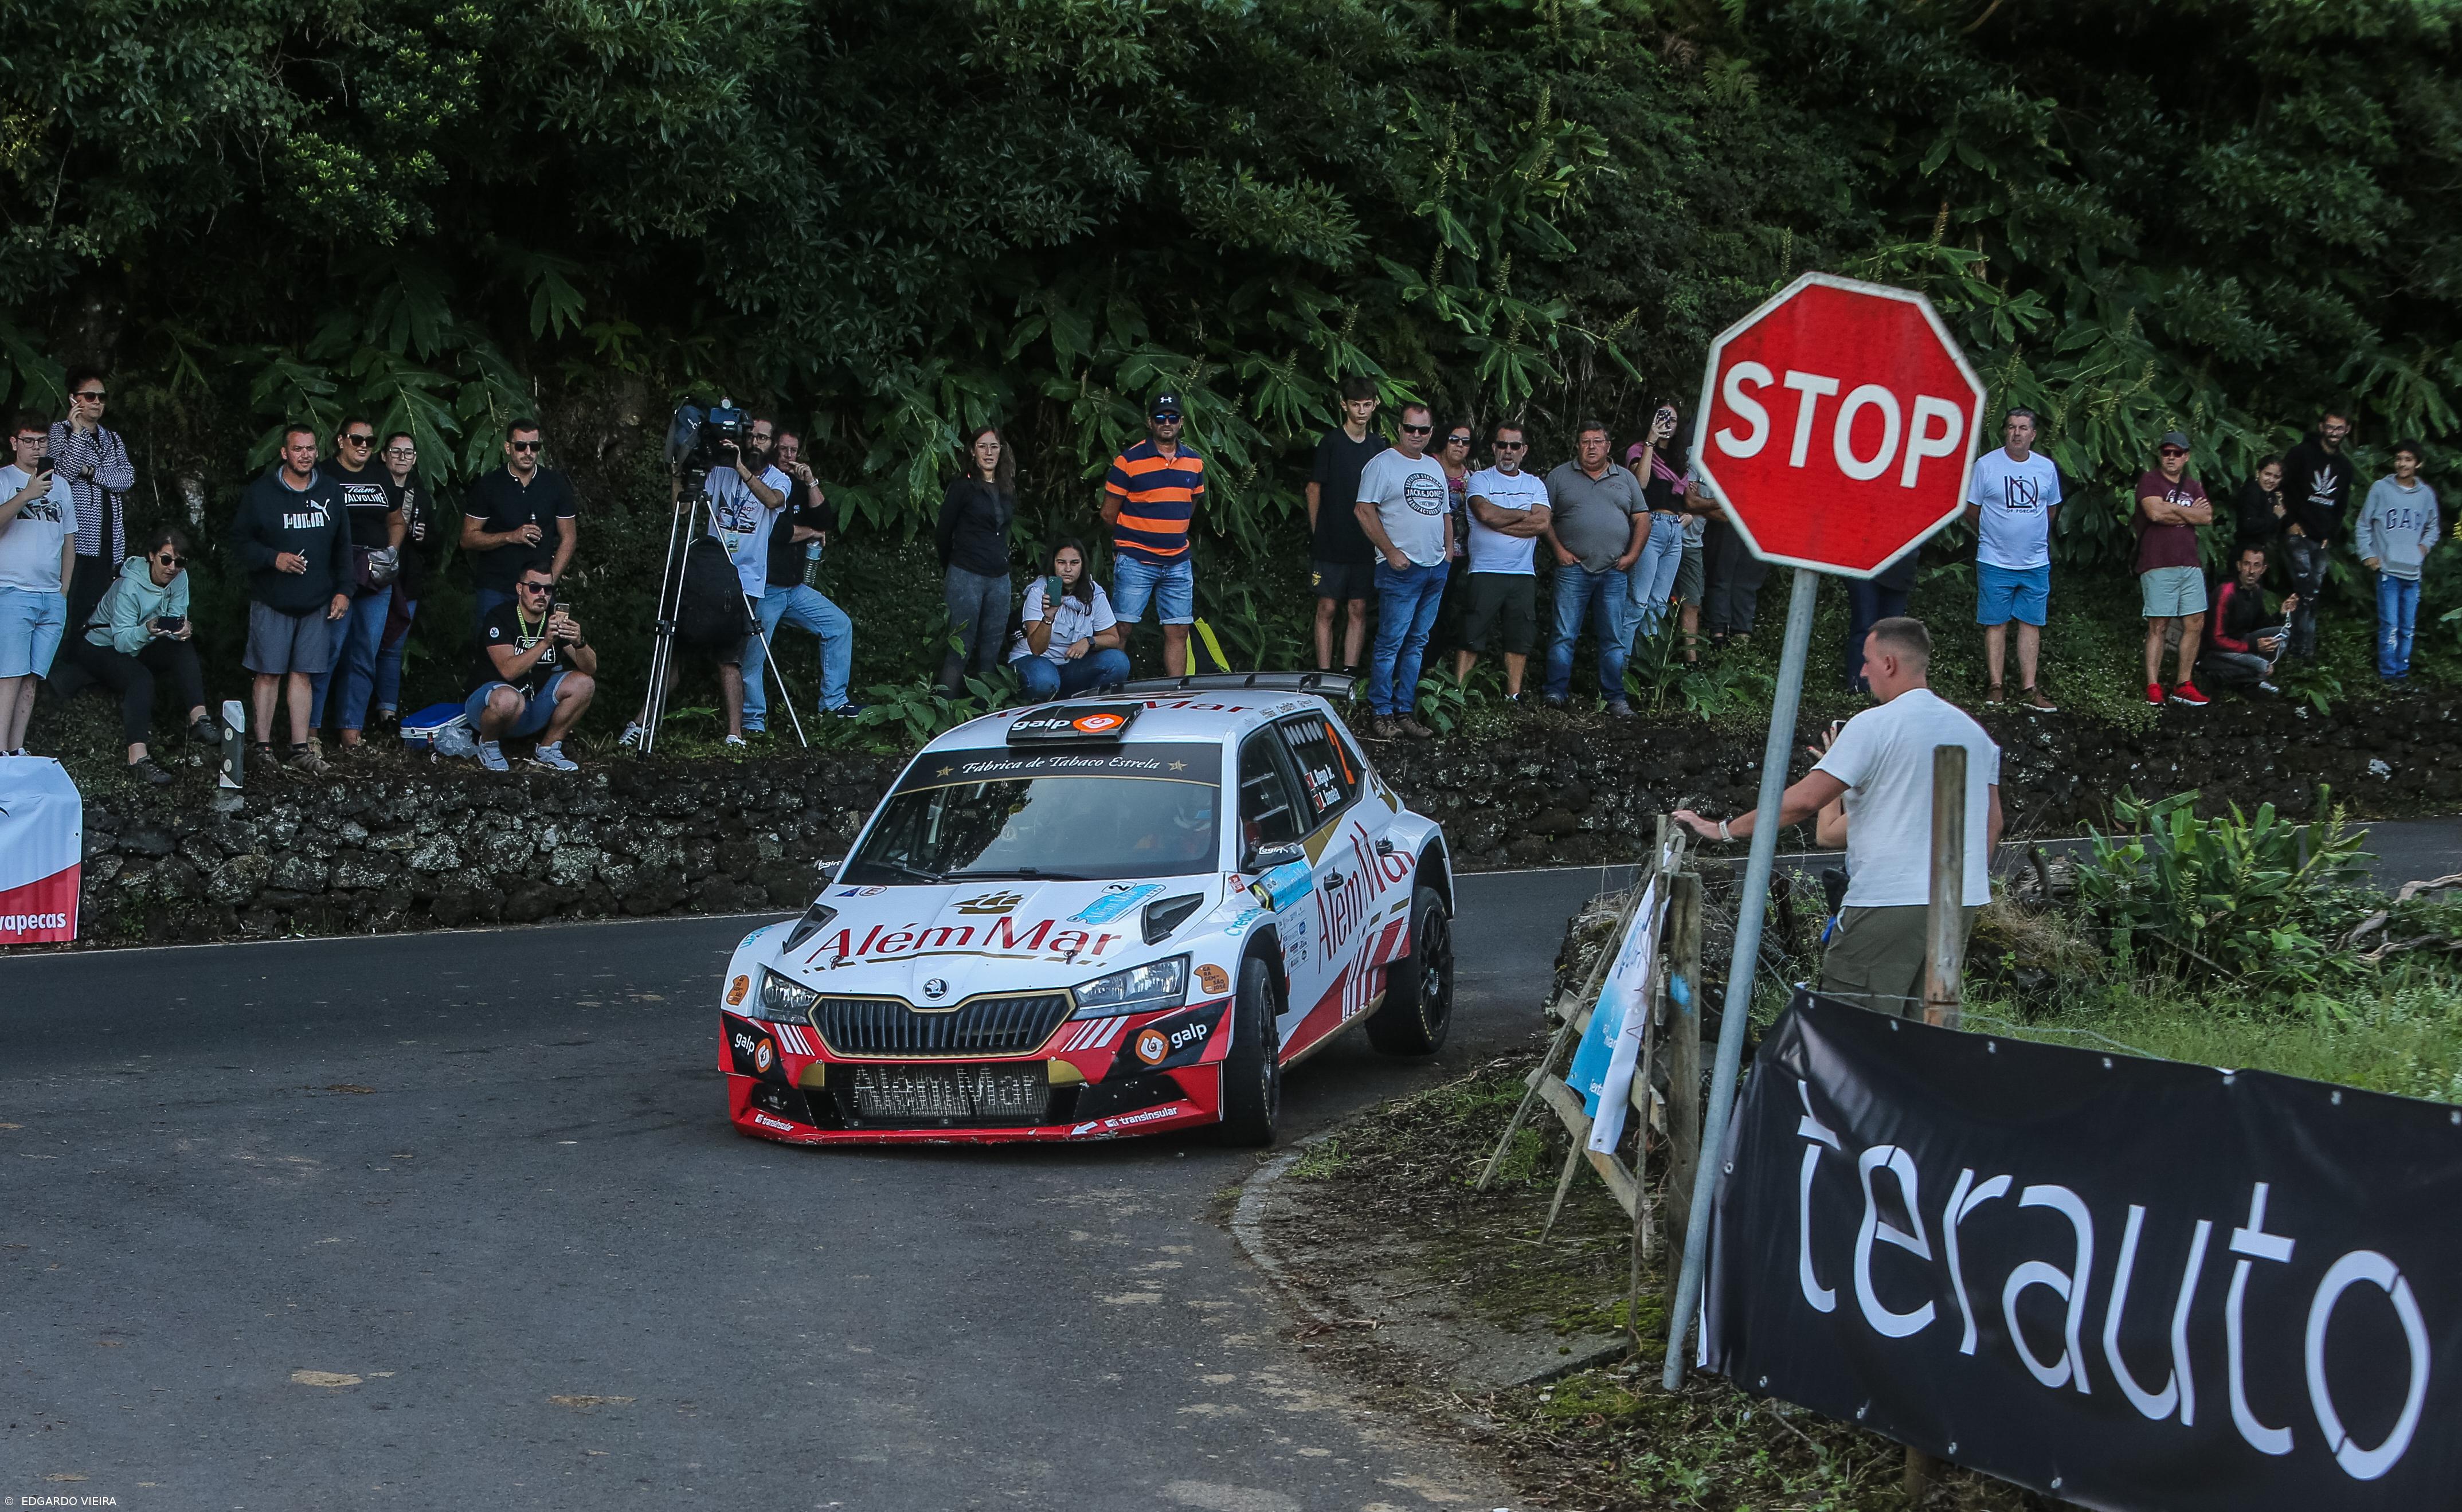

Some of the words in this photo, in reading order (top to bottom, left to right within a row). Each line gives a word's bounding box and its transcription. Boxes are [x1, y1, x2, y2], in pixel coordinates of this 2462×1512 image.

[1715, 361, 1964, 489] STOP
[283, 512, 324, 529] PUMA
[1011, 718, 1071, 731] galp
[962, 757, 1023, 774] Fábrica
[1025, 757, 1046, 769] de
[1049, 755, 1105, 768] Tabaco
[1109, 755, 1161, 770] Estrela
[1324, 722, 1356, 785] 2
[804, 922, 976, 965] Além
[982, 916, 1122, 957] Mar
[734, 1033, 755, 1055] galp
[1171, 1023, 1207, 1049] galp
[1118, 1107, 1178, 1125] transinsular
[1797, 1079, 2430, 1480] terauto
